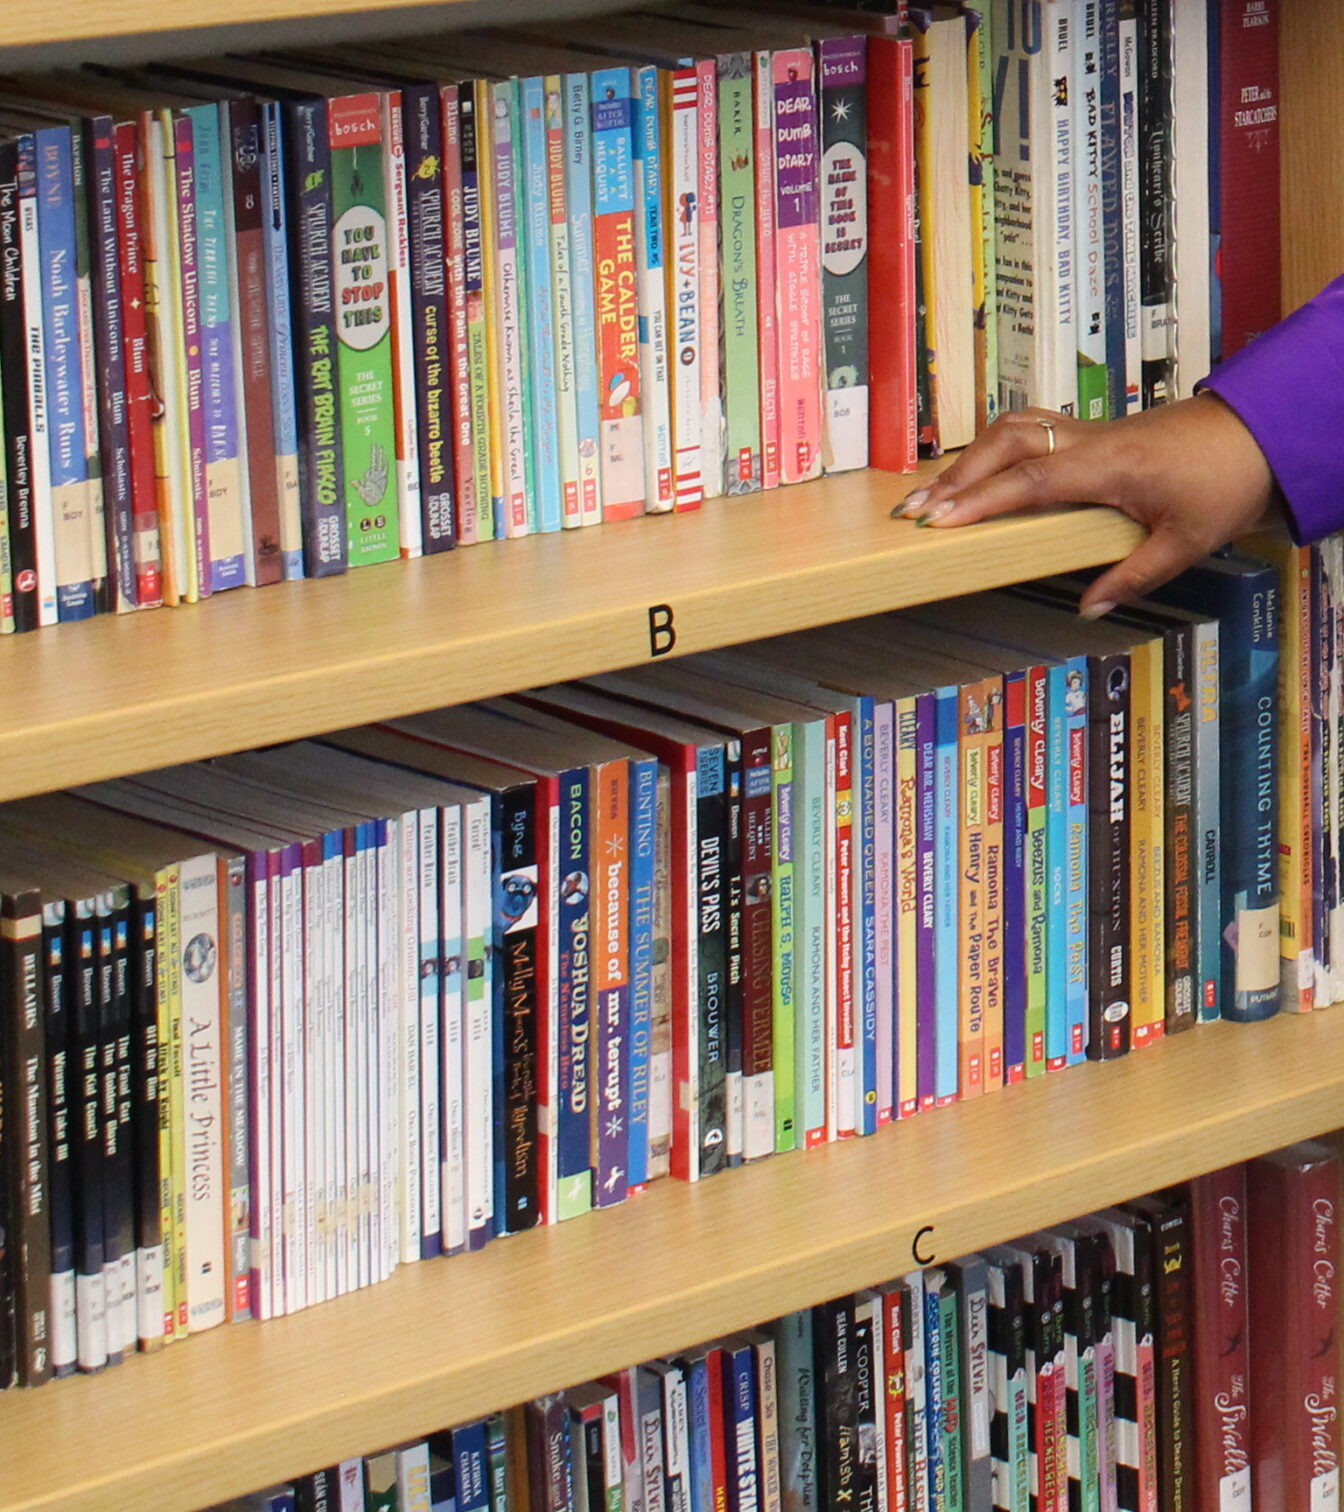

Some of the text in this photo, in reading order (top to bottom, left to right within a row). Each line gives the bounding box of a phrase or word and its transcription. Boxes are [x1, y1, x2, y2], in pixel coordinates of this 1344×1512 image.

[823, 62, 859, 76] bosch
[1240, 86, 1260, 104] PETER
[335, 122, 376, 136] bosch
[777, 97, 812, 115] DEAR
[778, 123, 812, 142] DUMB
[1234, 105, 1278, 127] STARCATCHERS
[778, 153, 813, 170] DIARY
[1056, 18, 1072, 325] BRUEL HAPPY BIRTHDAY, BAD KITTY
[497, 155, 512, 239] JUDY BLUME
[731, 91, 748, 337] BAKER DRAGON'S BREATH
[779, 182, 813, 196] VOLUME
[793, 199, 800, 212] 1
[0, 176, 20, 301] The Moon Children
[341, 244, 381, 264] HAVE
[344, 225, 376, 244] YOU
[463, 186, 482, 282] JUDY BLUME
[679, 242, 696, 279] IVY
[122, 152, 144, 373] The Dragon Prince Blum
[352, 265, 372, 281] TO
[422, 243, 444, 296] ACADEMY
[616, 218, 637, 359] THE CALDER
[342, 282, 383, 304] STOP
[599, 258, 617, 325] GAME
[678, 291, 696, 343] BEAN
[343, 311, 383, 329] THIS
[424, 306, 438, 342] curse
[51, 250, 75, 468] Noah Barleywater Runs
[427, 345, 438, 361] of
[427, 363, 439, 386] the
[427, 389, 442, 438] bizarro
[16, 435, 30, 529] Beverley Brenna
[428, 440, 444, 483] beetle
[648, 604, 678, 658] B
[1252, 592, 1263, 643] Conklin
[1265, 589, 1275, 640] Melanie
[1199, 639, 1218, 885] ULTRA CARROLL
[1256, 695, 1273, 896] COUNTING THYME
[1031, 677, 1046, 975] Beverly Cleary Beezus and Ramona
[1109, 710, 1125, 987] ELIJAH CURTIS
[864, 719, 876, 1041] A BOY NAMED QUEEN SARA CASSIDY
[570, 784, 589, 1114] BACON JOSHUA DREAD
[632, 770, 653, 1124] BUNTING THE SUMMER OF RILEY
[701, 836, 720, 1063] DEVIL'S PASS BROUWER
[986, 845, 1000, 1008] Ramona The Brave
[605, 861, 623, 1111] because of mr. terupt
[189, 1017, 218, 1202] A Little Princess
[911, 1226, 936, 1266] C
[1218, 1195, 1241, 1308] Charis Cotter
[1312, 1198, 1334, 1310] Charis Cotter
